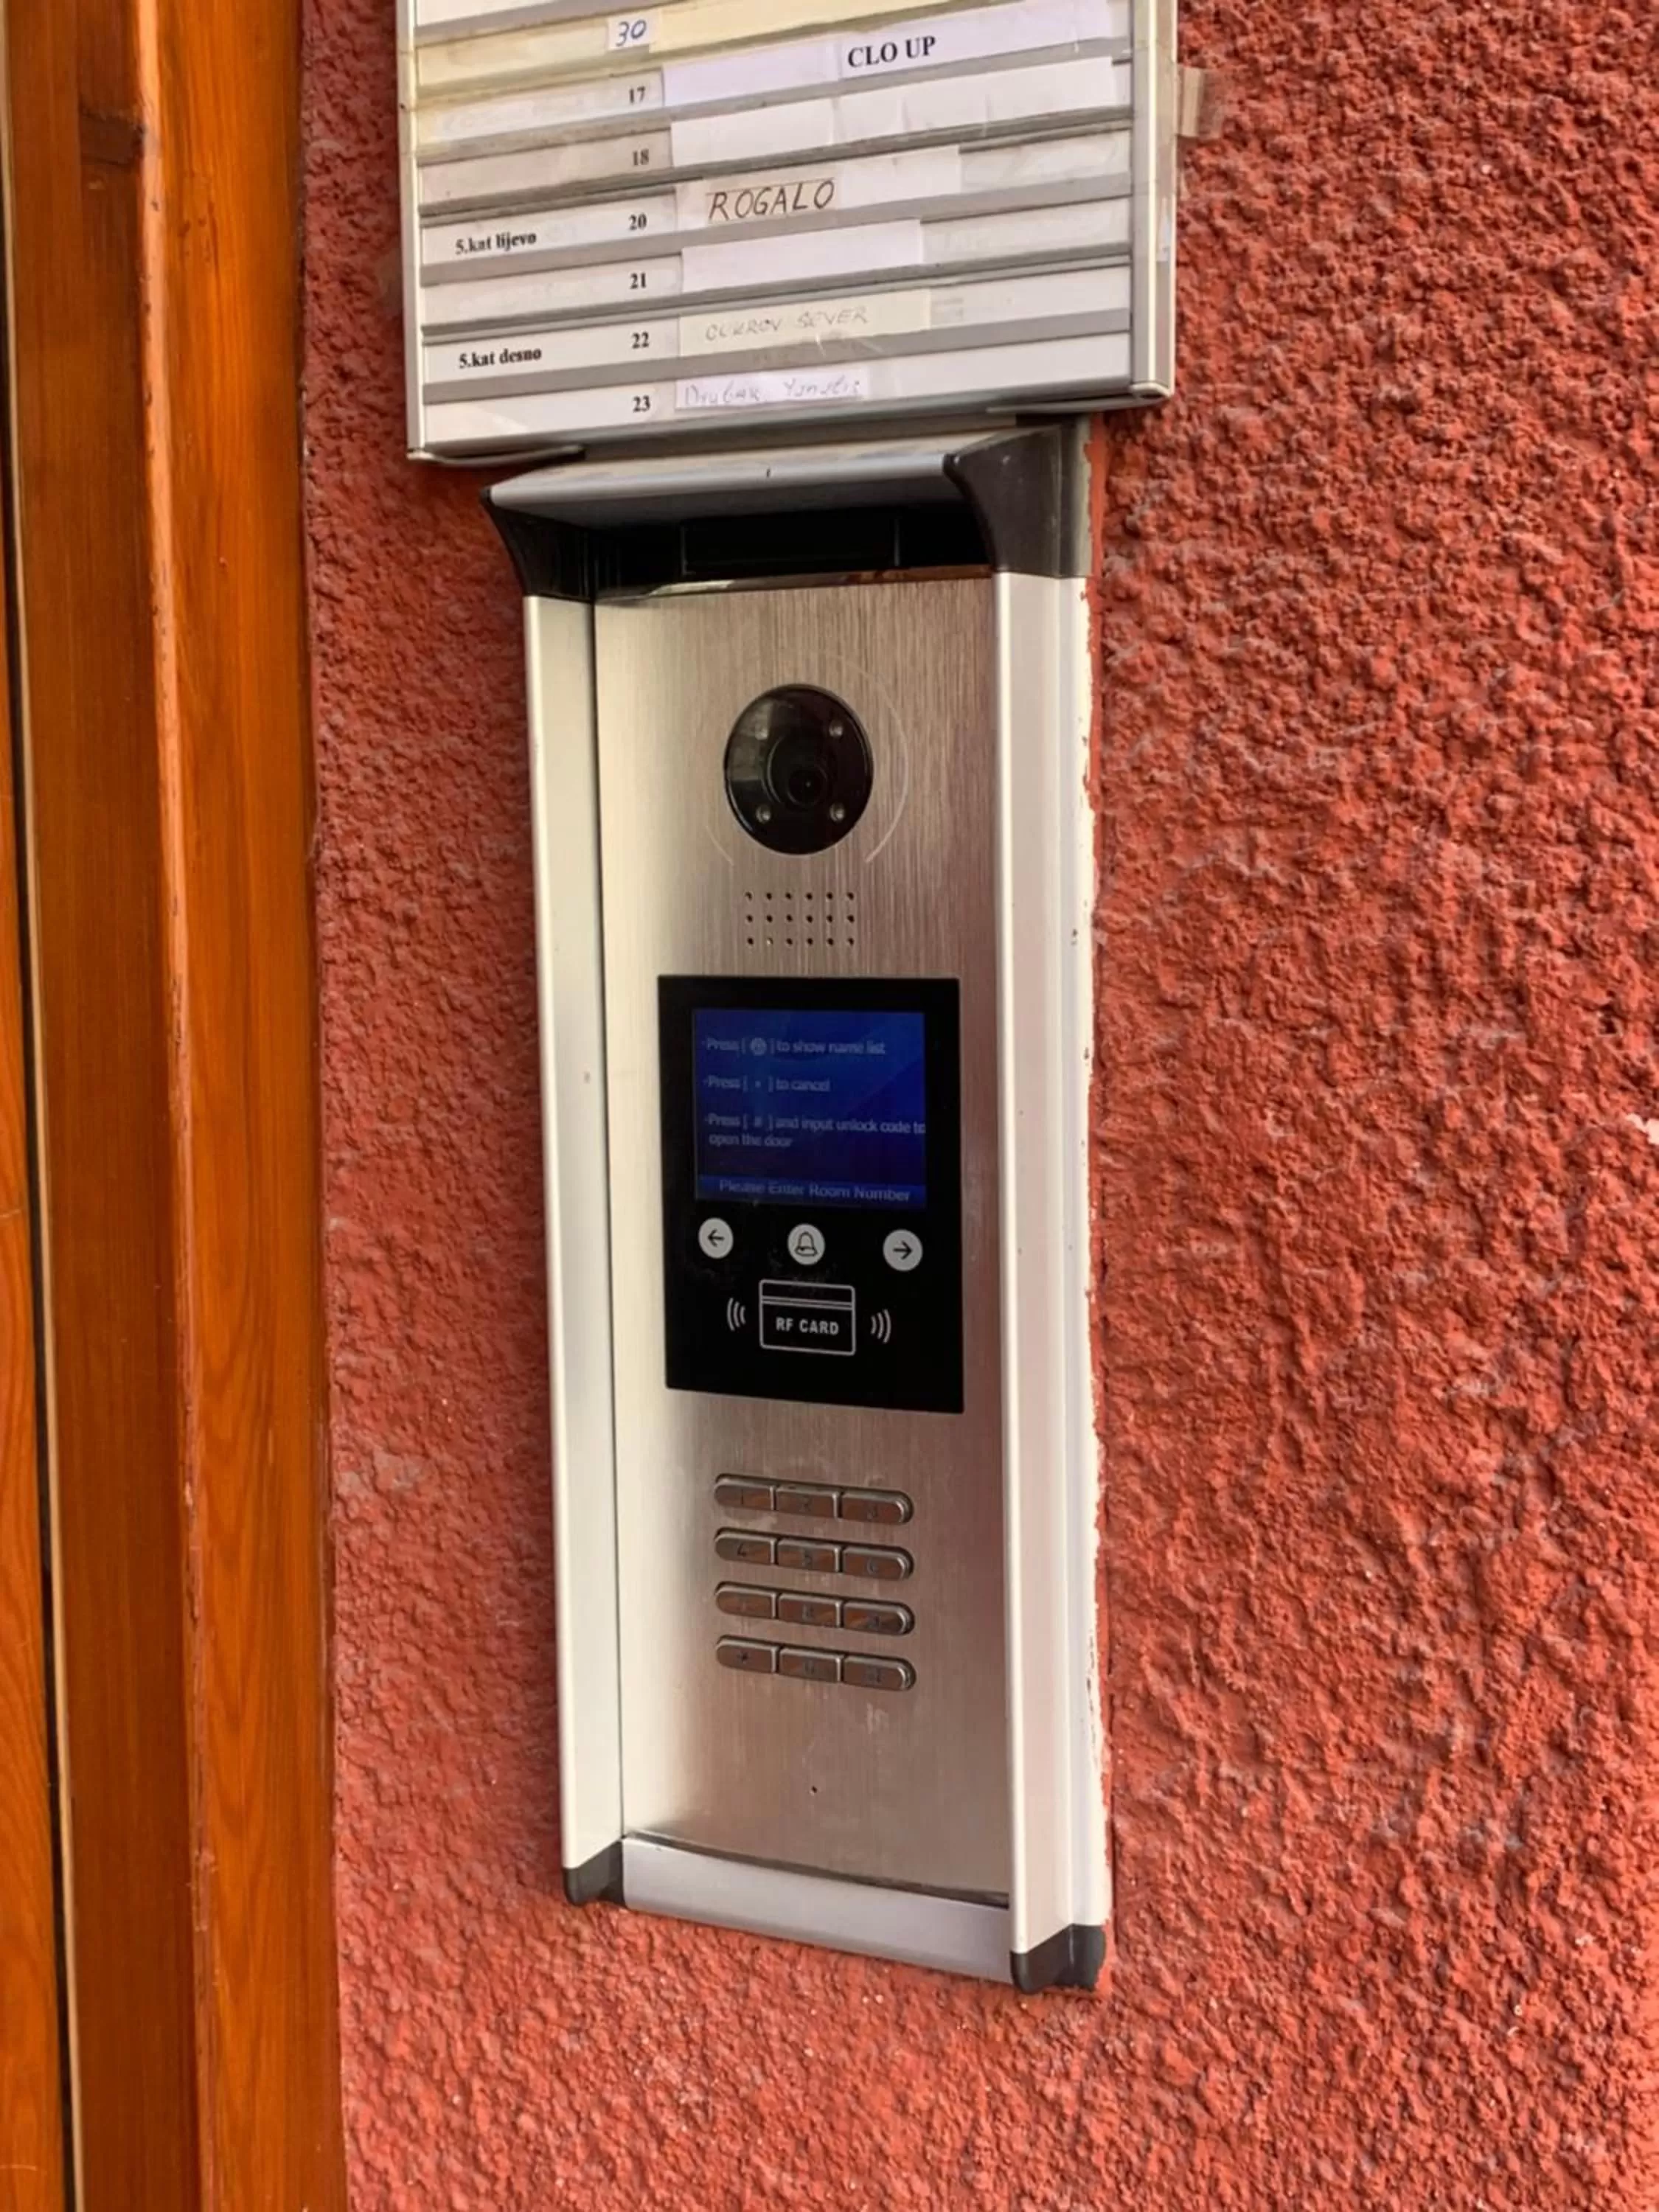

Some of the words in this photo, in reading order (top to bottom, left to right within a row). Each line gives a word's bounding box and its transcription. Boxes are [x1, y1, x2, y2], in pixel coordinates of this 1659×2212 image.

[615, 19, 648, 47] 30
[847, 41, 899, 68] CLO
[905, 35, 936, 59] UP
[629, 86, 646, 104] 17
[632, 148, 650, 167] 18
[708, 180, 835, 221] ROGALO
[628, 213, 648, 231] 20
[455, 237, 492, 255] 5.kat
[495, 232, 537, 251] lijevo
[630, 272, 647, 290] 21
[631, 332, 650, 349] 22
[459, 352, 495, 369] 5.kat
[499, 347, 542, 364] desno
[632, 395, 651, 414] 23
[776, 1038, 789, 1051] to
[793, 1039, 825, 1053] show
[829, 1041, 864, 1055] name
[866, 1039, 886, 1054] list
[775, 1079, 789, 1091] to
[791, 1079, 830, 1093] cancel
[776, 1116, 800, 1130] and
[802, 1117, 834, 1133] input
[837, 1119, 877, 1133] unlock
[880, 1121, 911, 1135] code
[913, 1121, 926, 1135] to
[709, 1134, 740, 1148] open
[742, 1132, 762, 1147] the
[764, 1133, 793, 1147] door
[719, 1179, 766, 1194] Please
[768, 1182, 804, 1196] Enter
[808, 1184, 851, 1199] Room
[853, 1186, 911, 1202] Number
[775, 1316, 794, 1332] RF
[799, 1318, 840, 1335] CARD
